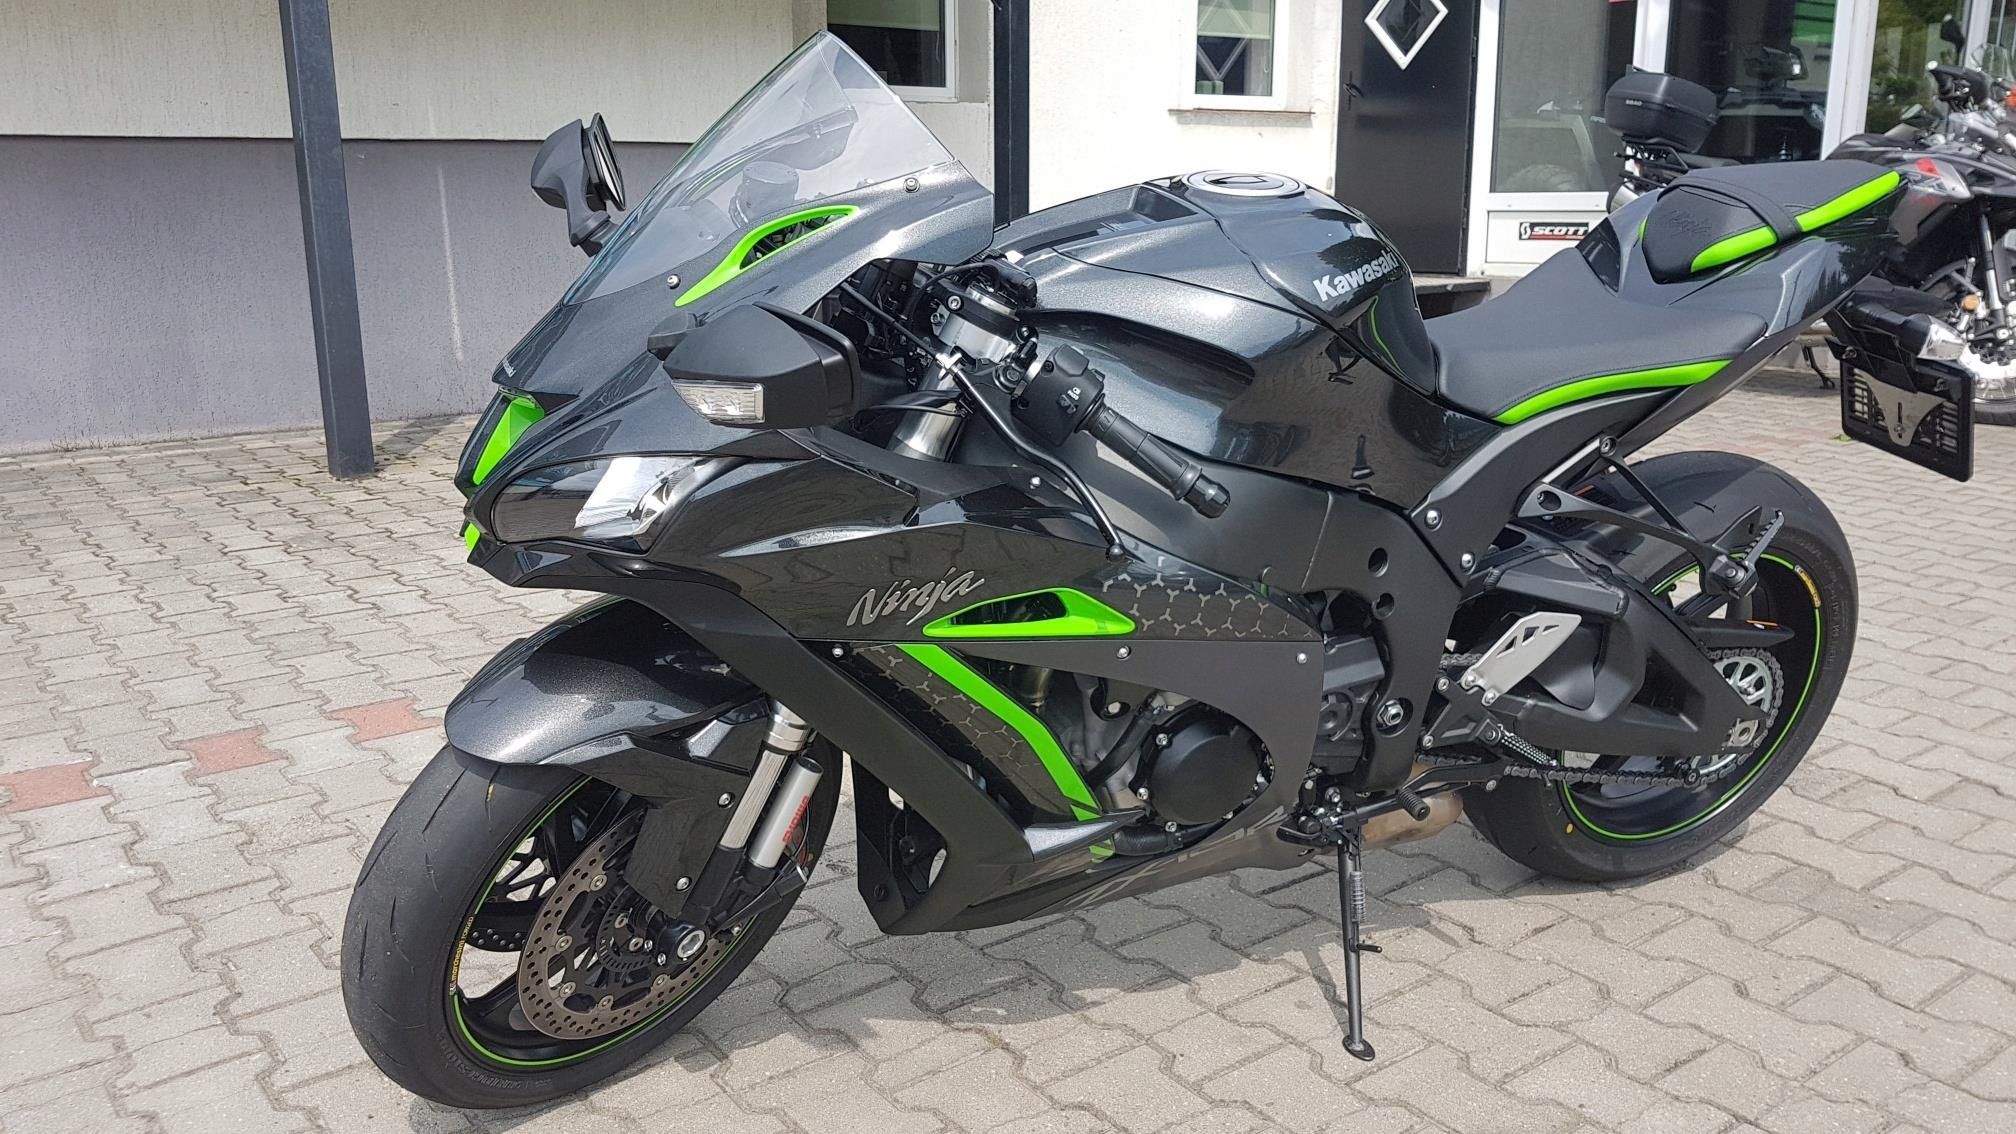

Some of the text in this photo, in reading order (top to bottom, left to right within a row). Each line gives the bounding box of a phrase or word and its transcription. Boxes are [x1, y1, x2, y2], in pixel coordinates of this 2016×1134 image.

[1532, 226, 1588, 236] SCOTT
[1312, 249, 1400, 302] Kawasaki
[846, 566, 985, 627] Ninja
[451, 940, 465, 983] marchesini
